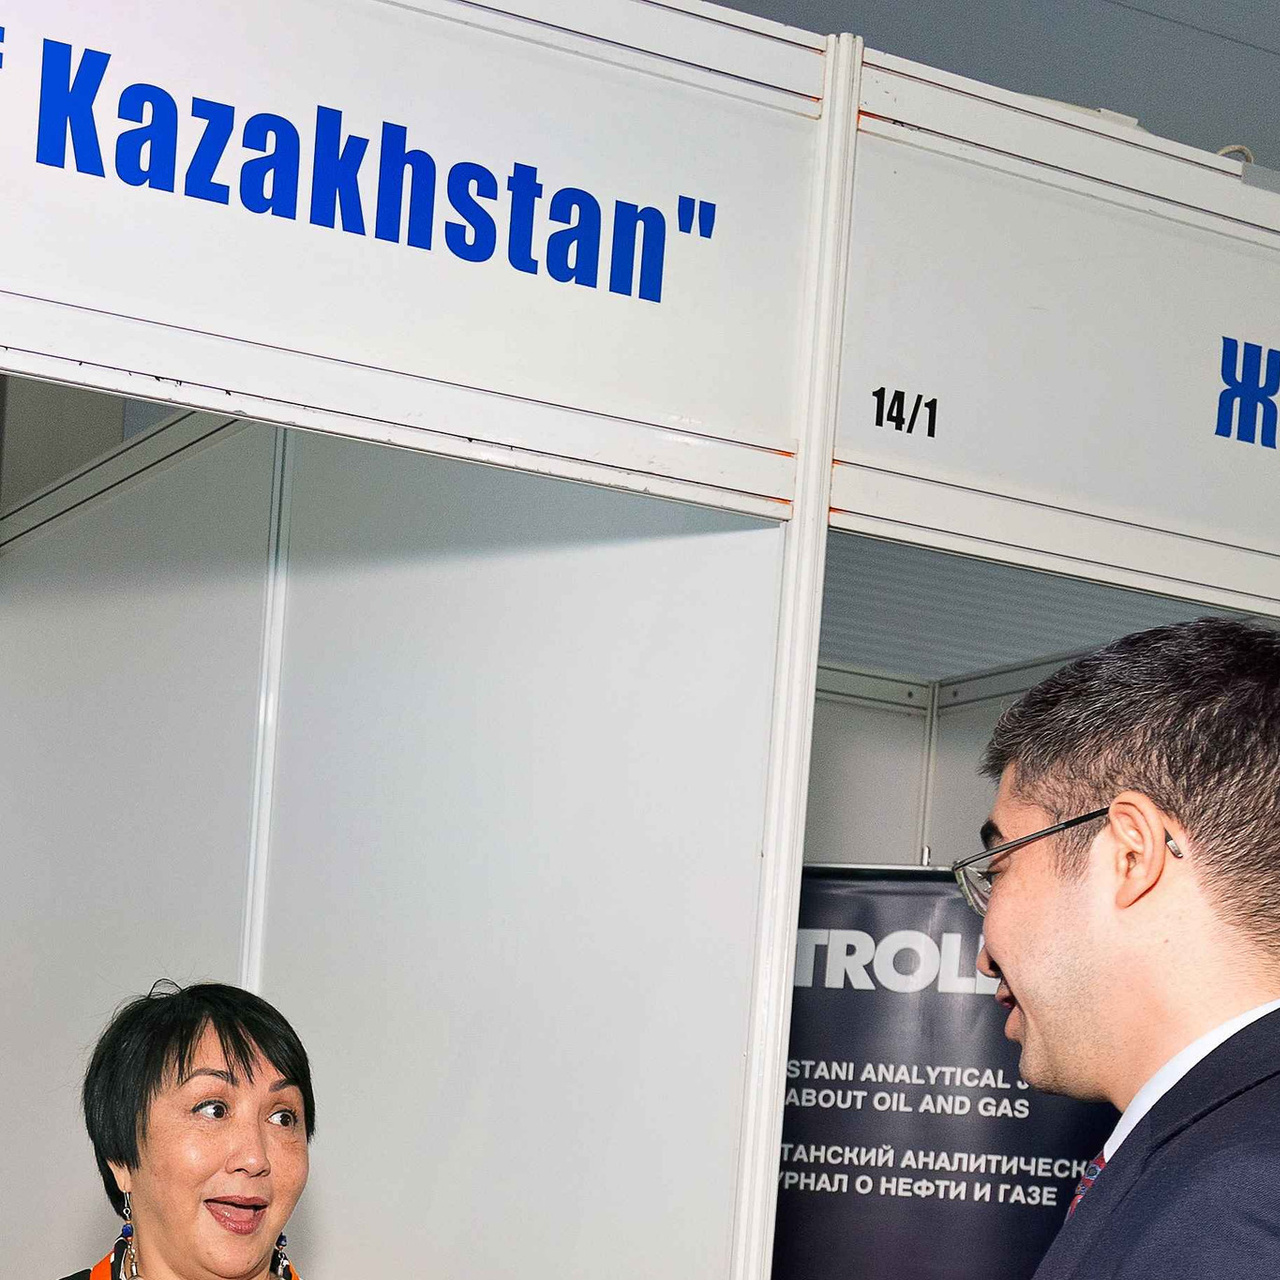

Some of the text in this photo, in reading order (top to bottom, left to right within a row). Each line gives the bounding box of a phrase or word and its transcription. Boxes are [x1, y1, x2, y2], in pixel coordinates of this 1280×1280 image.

[35, 38, 716, 304] Kazakhstan"
[872, 386, 938, 438] 14/1
[794, 928, 1001, 995] TROL
[786, 1060, 854, 1081] STANI
[860, 1062, 1011, 1089] ANALYTICAL
[784, 1088, 1030, 1118] ABOUT OIL AND GAS
[781, 1143, 895, 1168] ТАНСКИЙ
[855, 1175, 874, 1195] О
[880, 1176, 967, 1200] НЕФТИ
[973, 1182, 991, 1203] И
[999, 1184, 1058, 1206] ГАЗЕ
